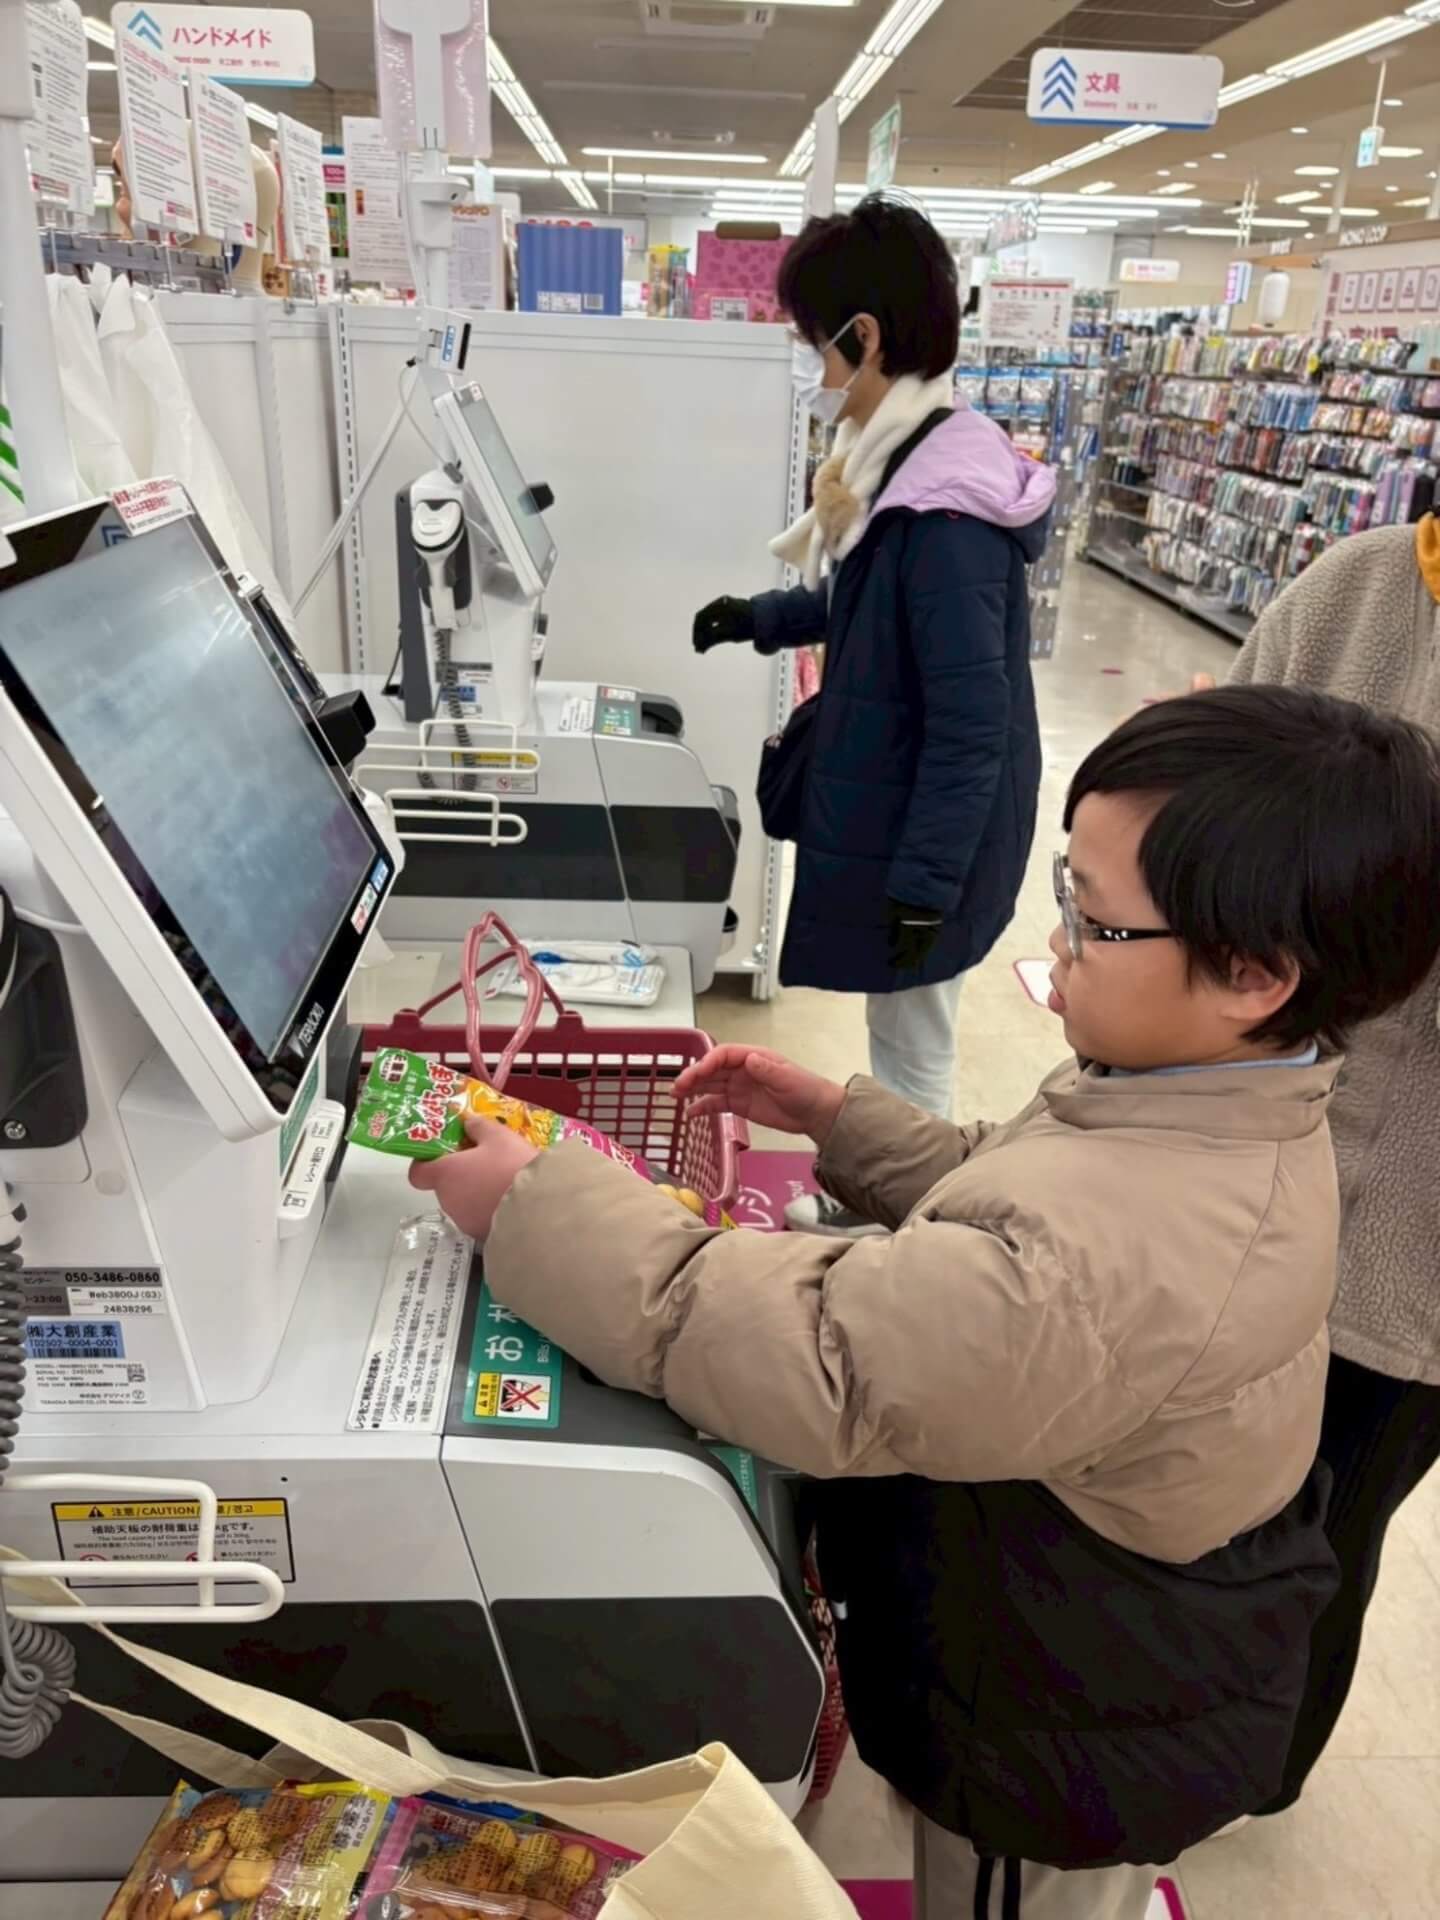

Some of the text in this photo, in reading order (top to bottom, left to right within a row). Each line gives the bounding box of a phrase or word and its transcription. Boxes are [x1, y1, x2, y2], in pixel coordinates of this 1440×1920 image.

[172, 26, 272, 48] ハンドメイド
[1085, 72, 1120, 93] 文具
[65, 1271, 160, 1283] 050-3486-0860
[142, 1505, 195, 1516] CAUTION
